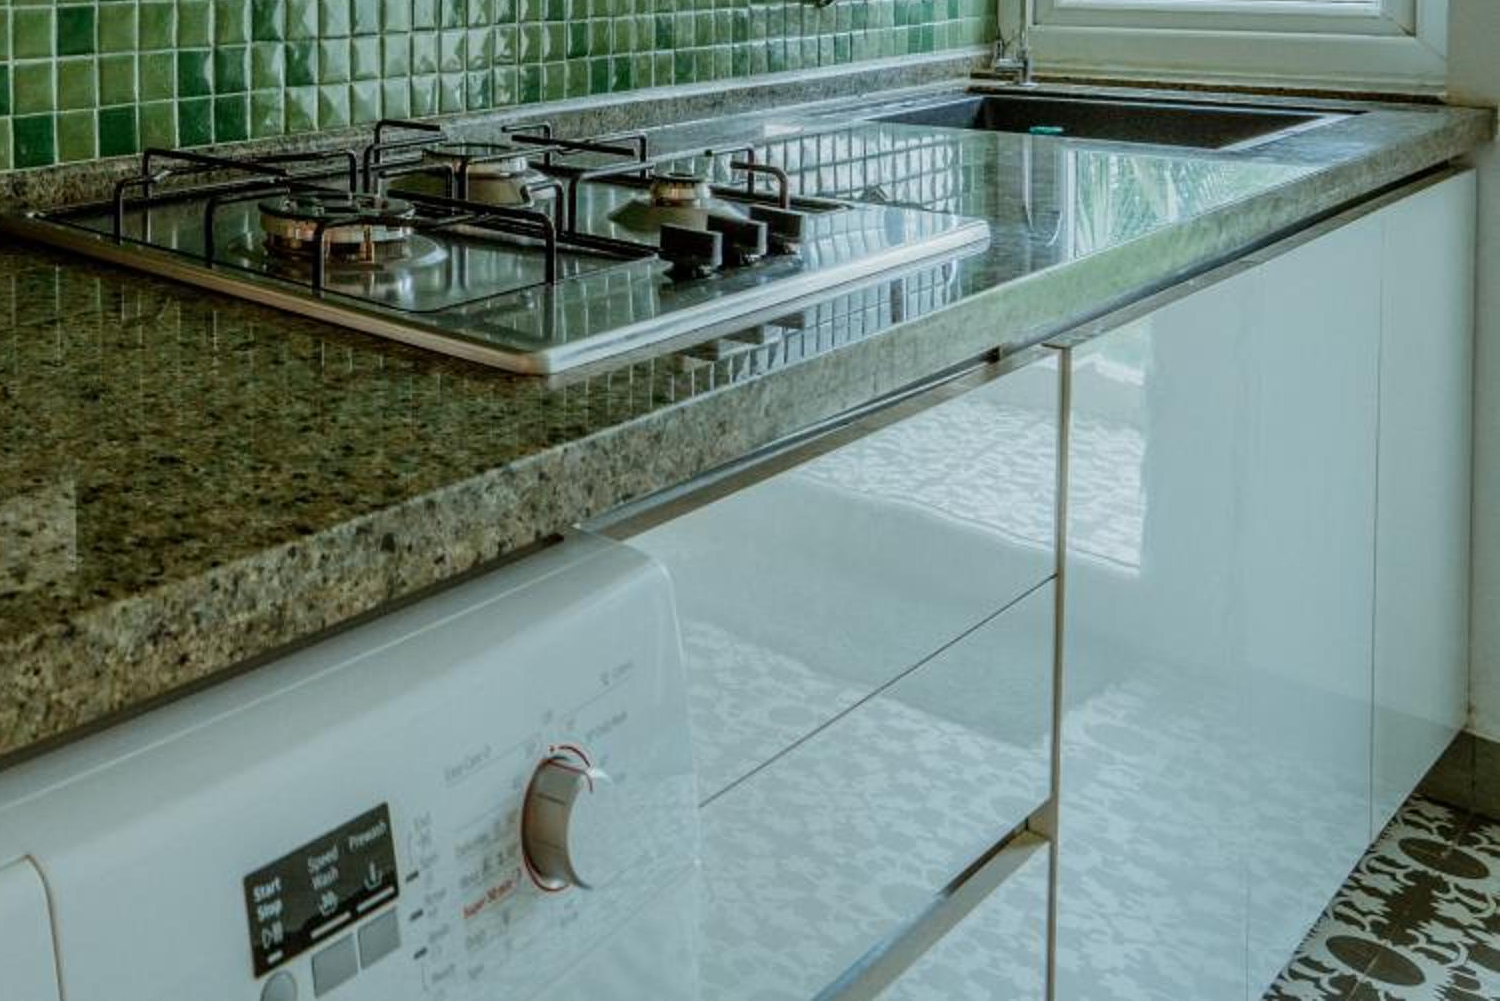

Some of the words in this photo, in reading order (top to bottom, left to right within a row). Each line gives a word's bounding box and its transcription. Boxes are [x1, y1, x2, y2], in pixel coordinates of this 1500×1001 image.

[307, 844, 339, 874] Speed
[253, 876, 282, 902] Start
[312, 866, 340, 890] Wash
[257, 898, 283, 922] Stop
